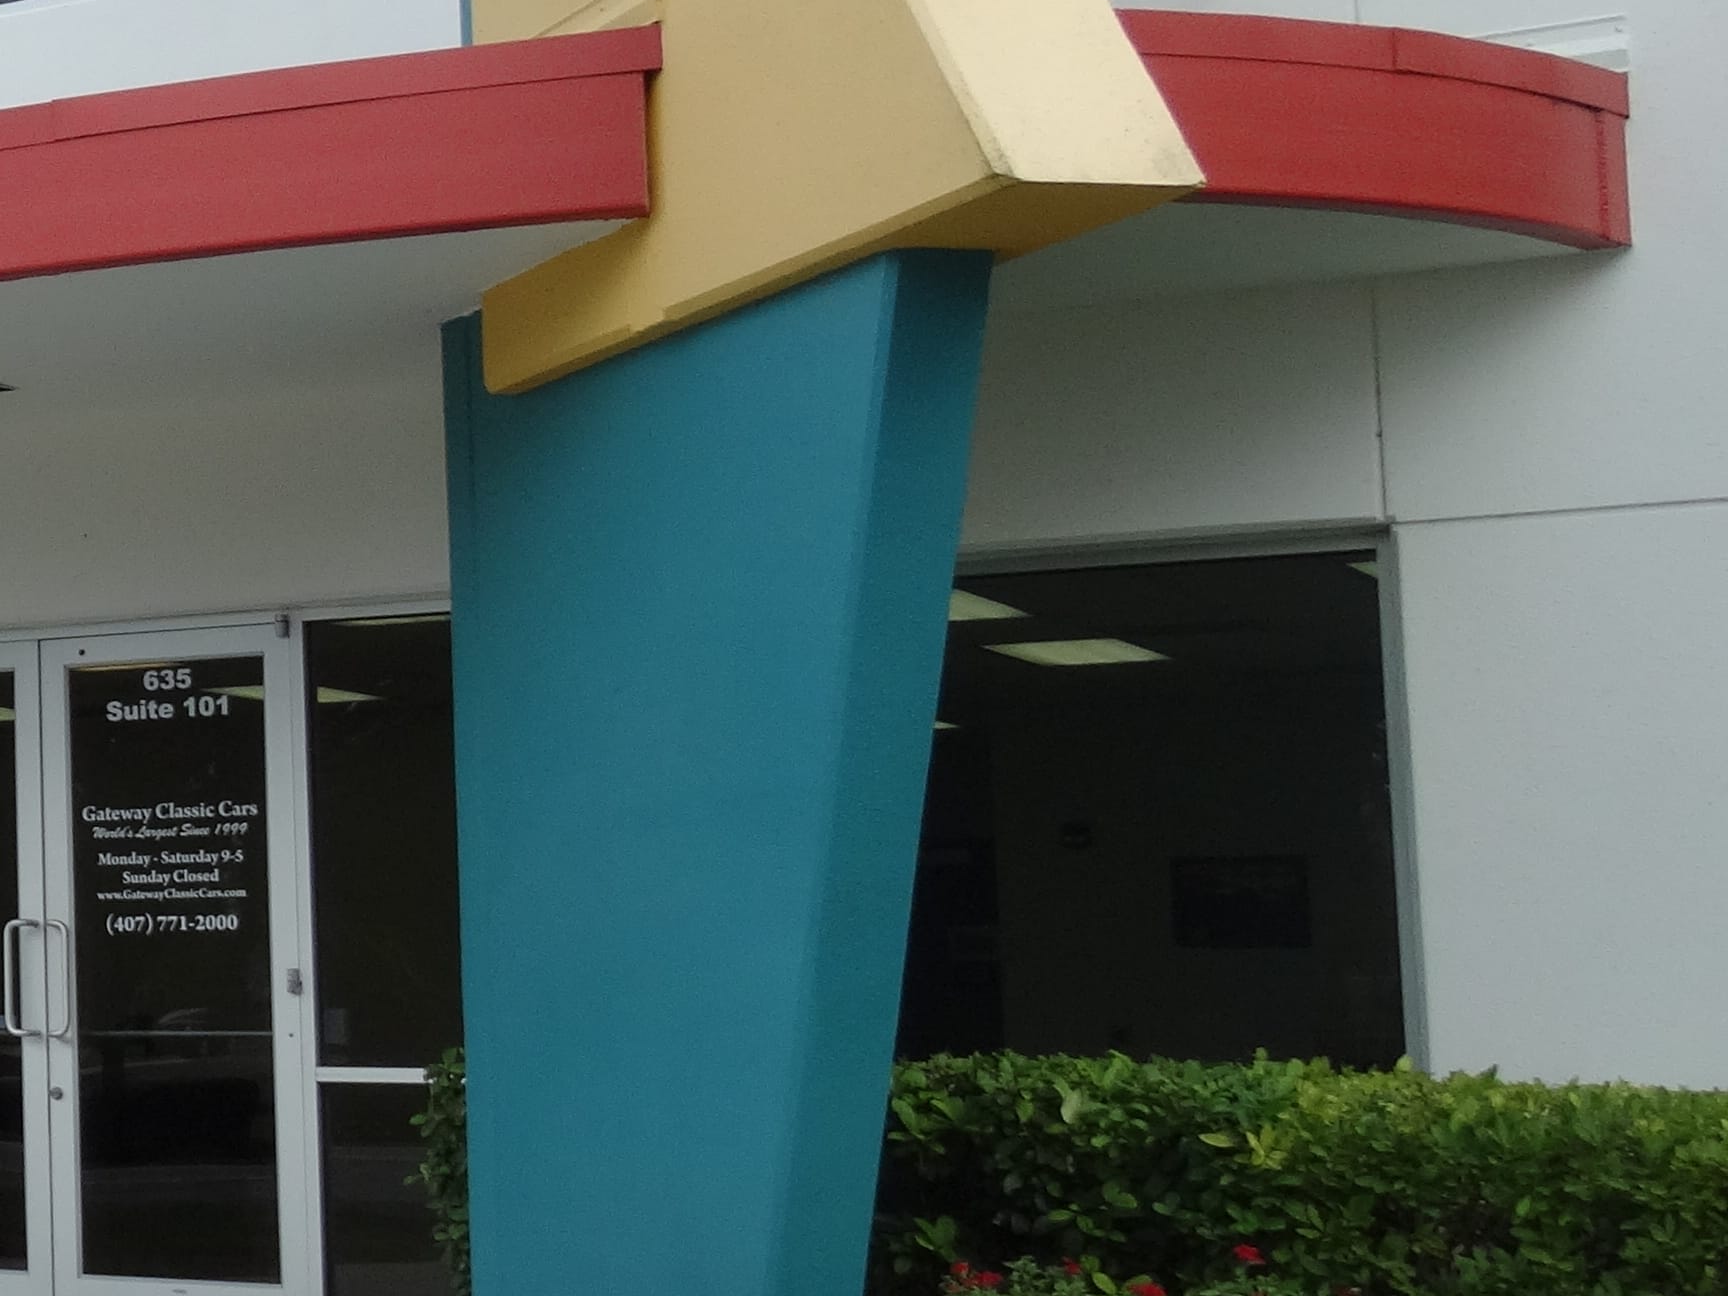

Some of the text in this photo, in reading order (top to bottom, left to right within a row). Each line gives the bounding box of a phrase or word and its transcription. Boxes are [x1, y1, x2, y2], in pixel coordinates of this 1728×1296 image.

[142, 668, 192, 691] 635
[105, 695, 229, 722] Suite 101
[82, 800, 258, 824] Gateway Classic Cars
[92, 822, 248, 841] World's Largest Since 1999
[97, 851, 151, 867] Monday
[160, 850, 219, 866] Saturday
[221, 849, 244, 863] 9-5
[122, 868, 220, 886] Sunday Closed
[96, 888, 247, 901] www.GatewayClassicCars.com
[106, 912, 239, 936] (407) 771-2000
